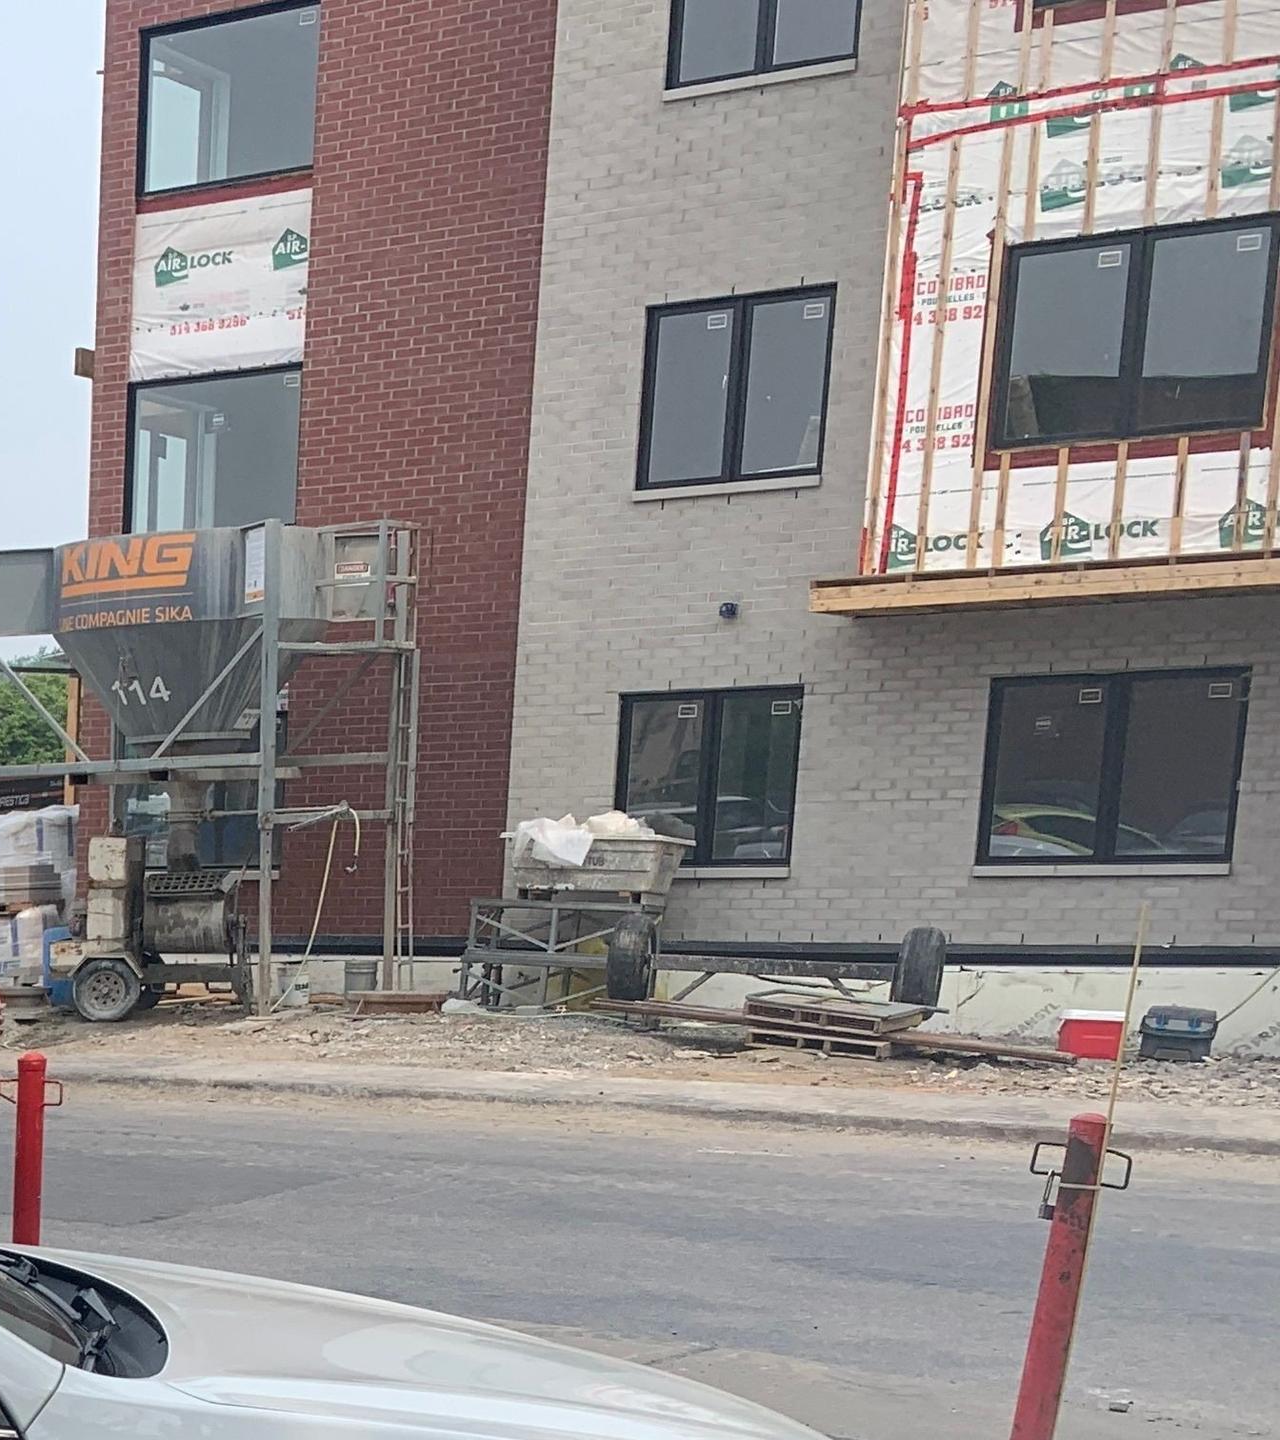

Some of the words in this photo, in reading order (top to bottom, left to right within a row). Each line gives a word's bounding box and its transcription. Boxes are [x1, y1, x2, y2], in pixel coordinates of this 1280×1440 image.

[62, 533, 197, 585] KING
[75, 608, 150, 630] COMPAGNIE
[155, 605, 193, 623] SIKA
[112, 676, 171, 705] 114
